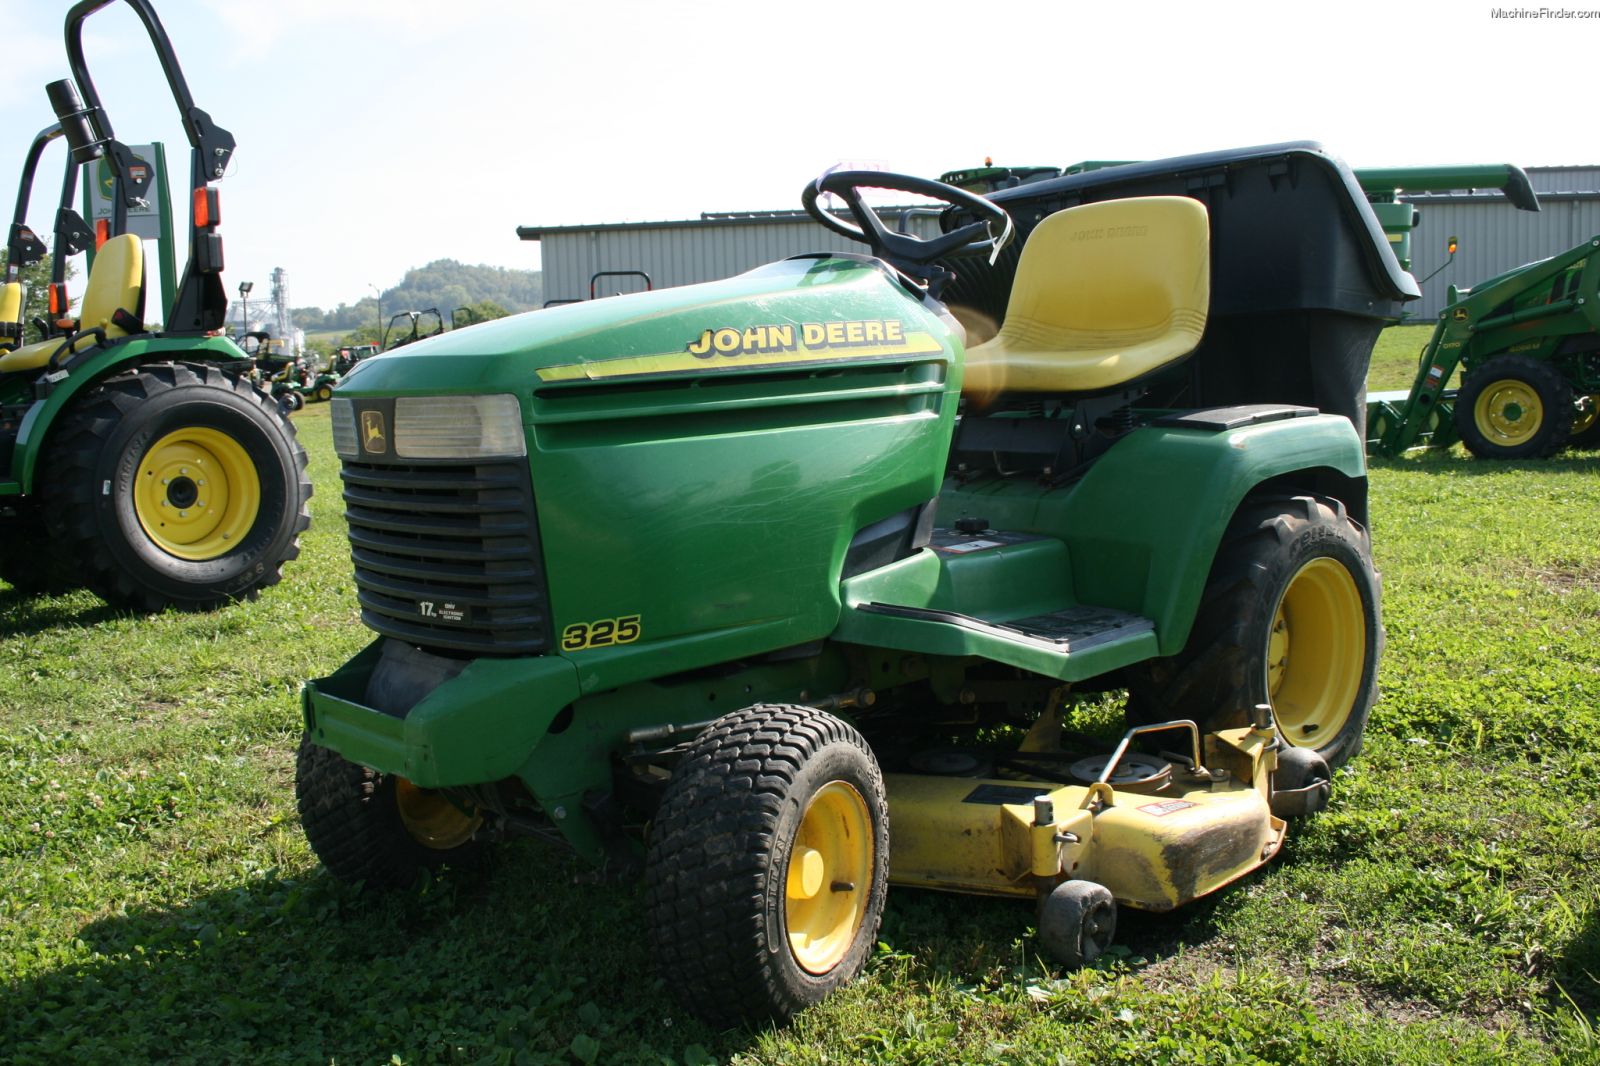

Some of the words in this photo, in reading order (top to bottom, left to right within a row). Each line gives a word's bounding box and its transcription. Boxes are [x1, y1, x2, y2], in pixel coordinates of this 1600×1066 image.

[683, 324, 797, 359] JOHN
[801, 319, 906, 350] DEERE
[562, 614, 641, 651] 325
[768, 837, 787, 912] TITAN
